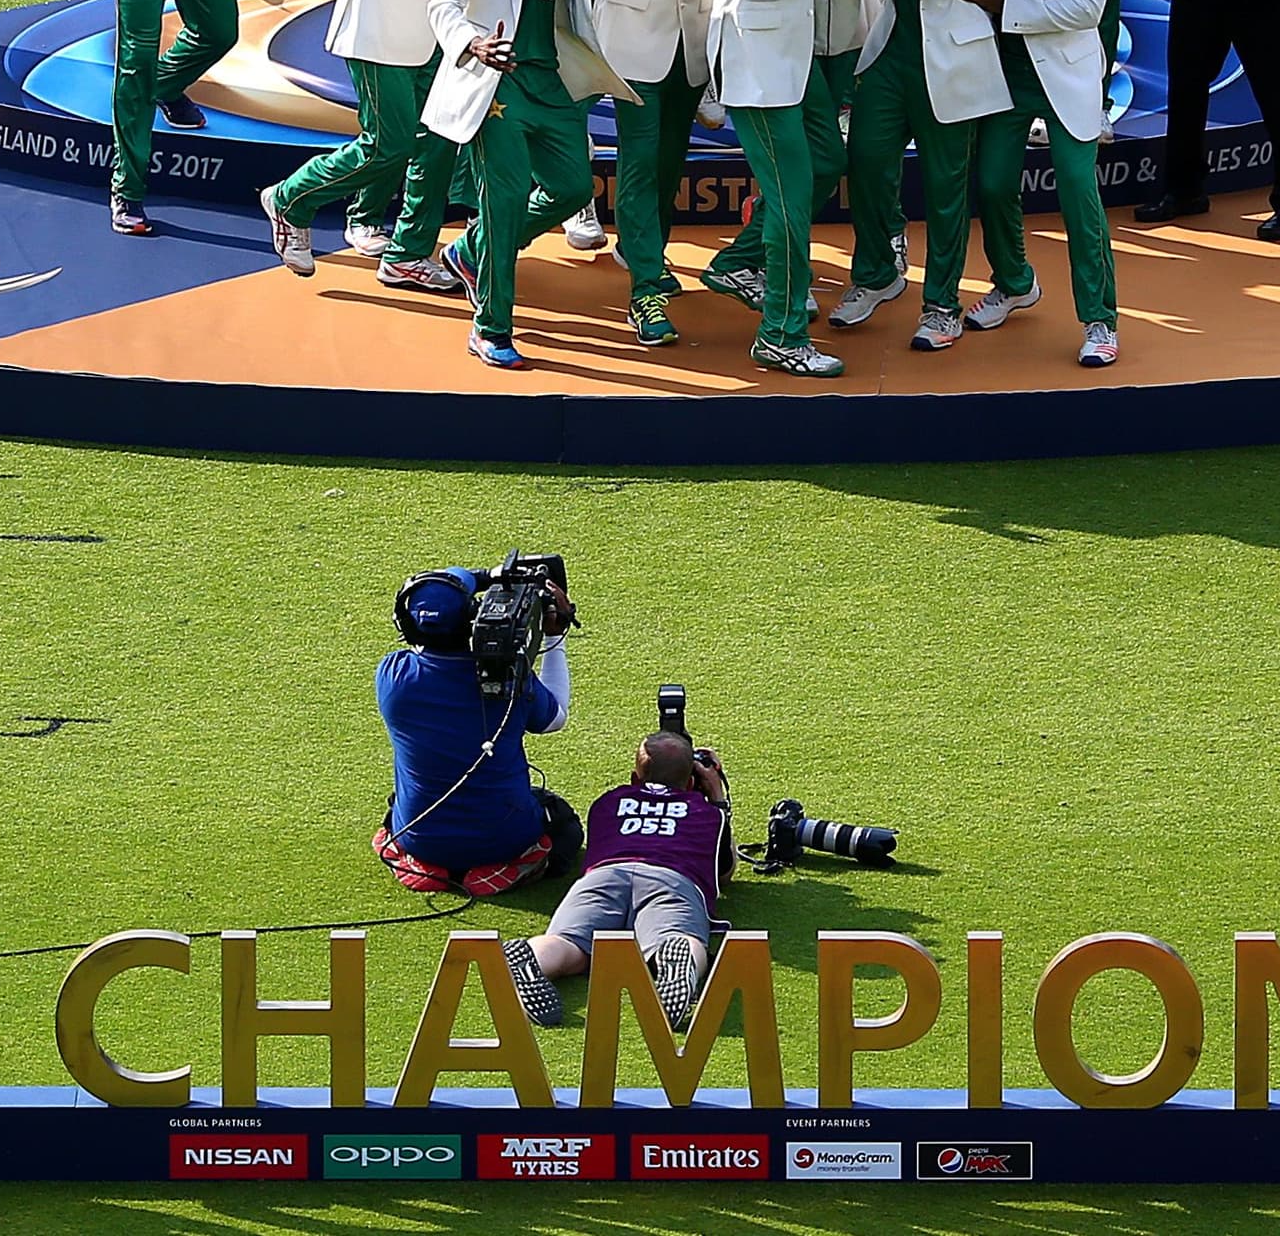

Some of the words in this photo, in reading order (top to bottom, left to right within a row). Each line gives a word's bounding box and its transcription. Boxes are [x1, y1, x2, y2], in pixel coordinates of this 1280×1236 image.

[61, 137, 80, 163] &
[169, 153, 224, 181] 2017
[1136, 157, 1158, 182] &
[617, 798, 688, 818] RHB
[620, 817, 677, 836] 053
[169, 1118, 209, 1128] GLOBAL
[211, 1118, 262, 1128] PARTNERS
[786, 1118, 817, 1128] EVENT
[820, 1118, 871, 1128] PARTNERS
[185, 1148, 293, 1165] NISSAN
[330, 1146, 455, 1167] oppo
[501, 1137, 591, 1157] MRF
[642, 1144, 760, 1169] Emirates
[512, 1161, 579, 1176] TYRES
